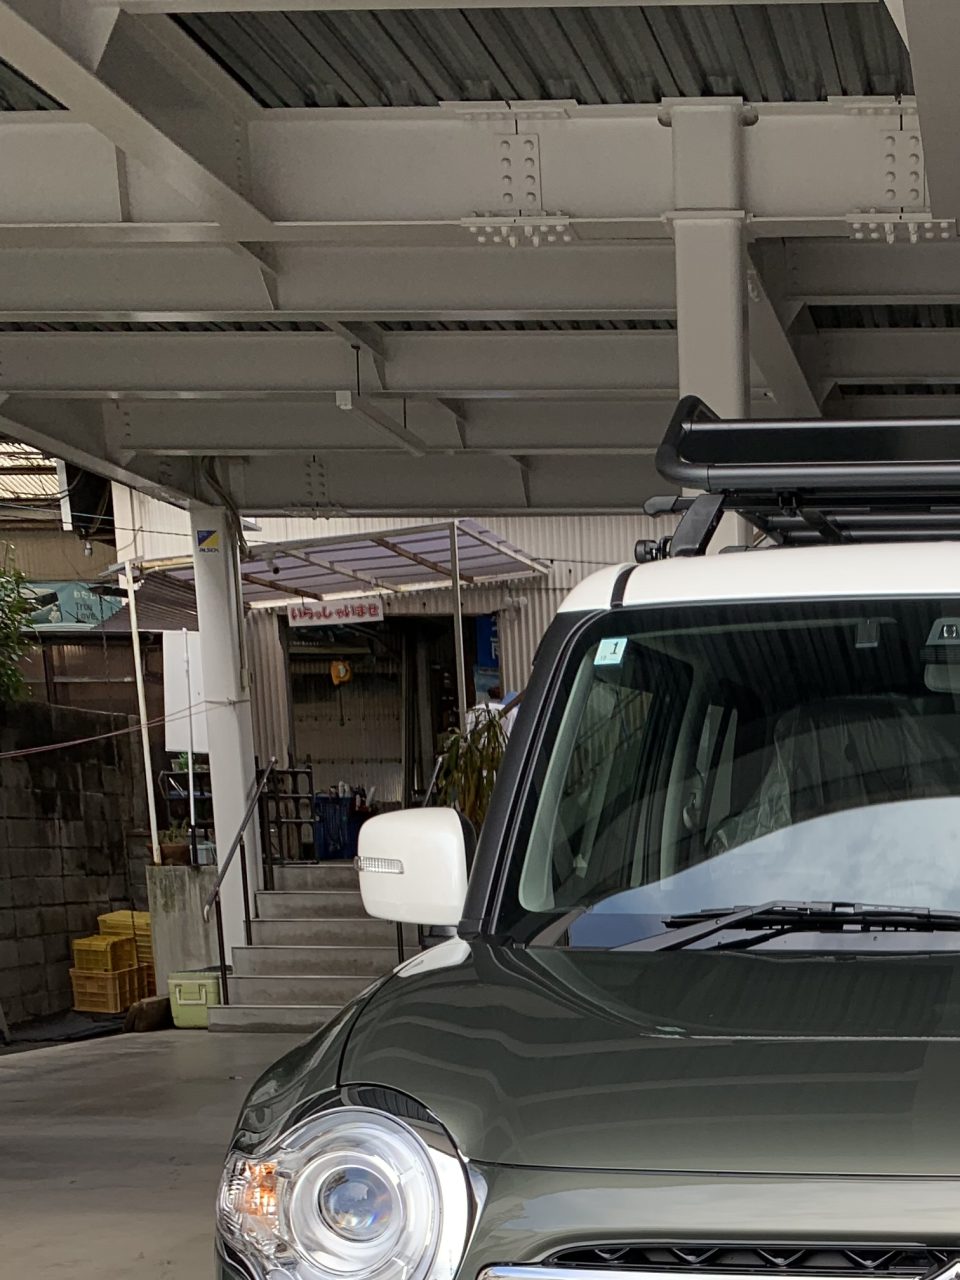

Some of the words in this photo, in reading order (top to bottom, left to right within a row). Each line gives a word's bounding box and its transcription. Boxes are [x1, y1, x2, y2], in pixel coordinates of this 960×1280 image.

[290, 603, 380, 621] いらっしゃいませ
